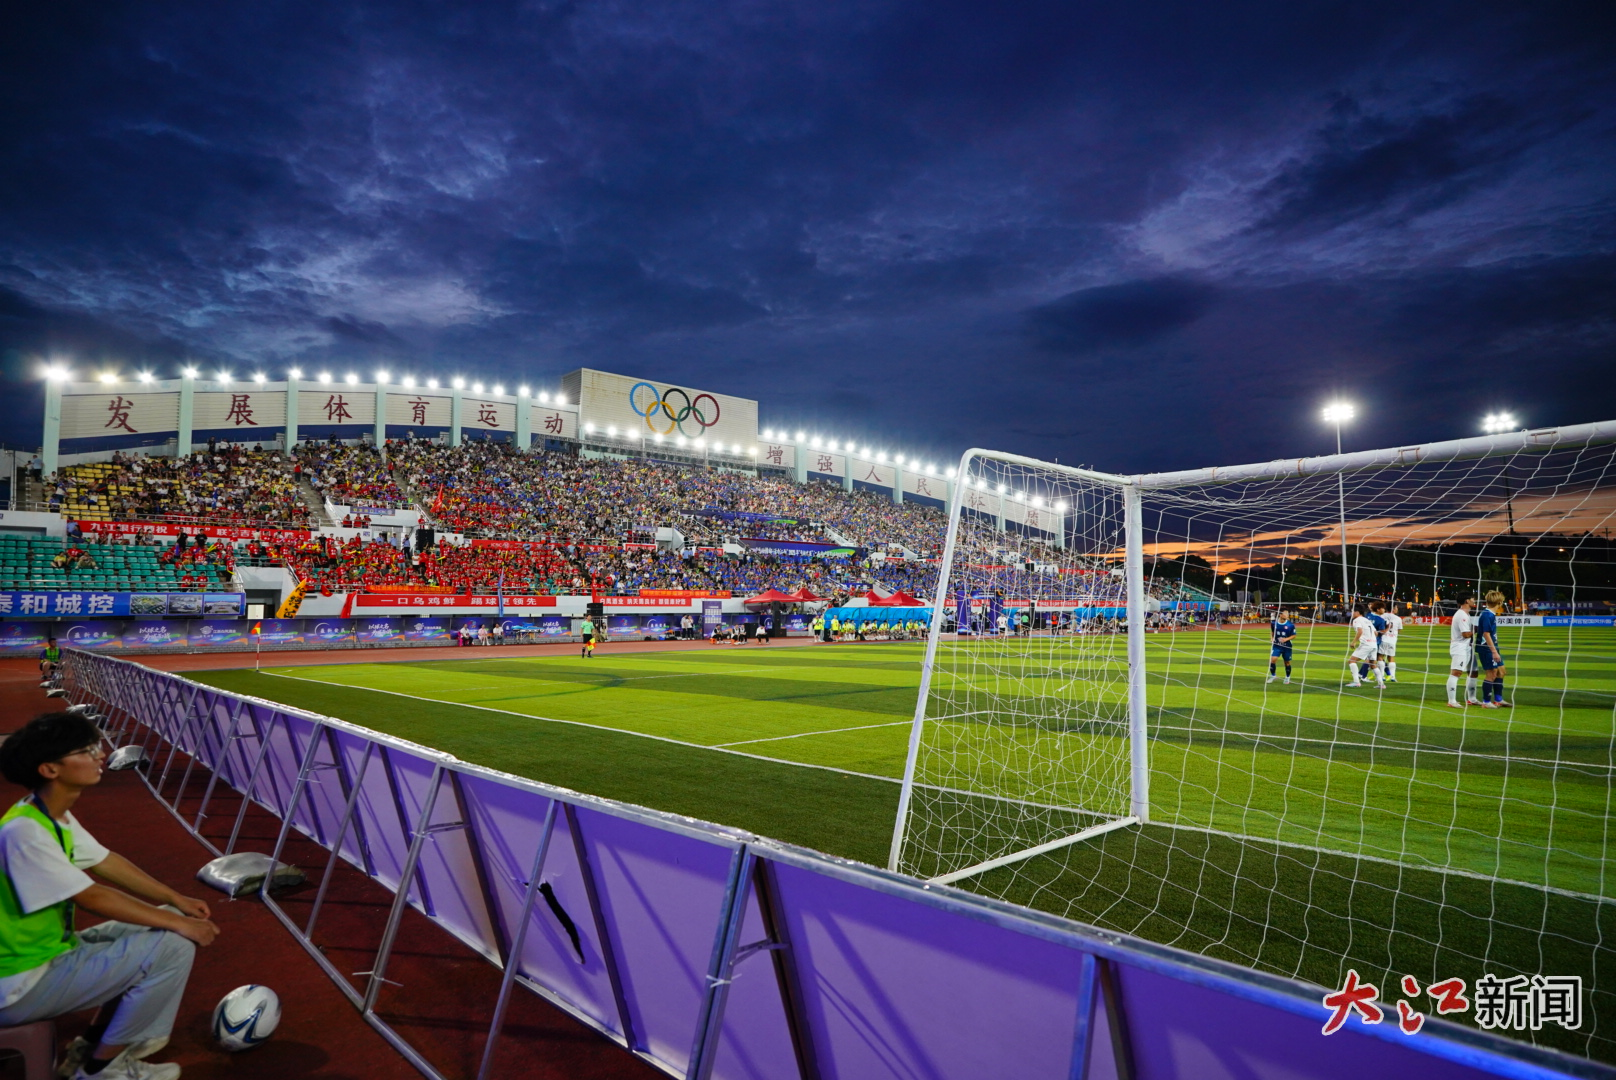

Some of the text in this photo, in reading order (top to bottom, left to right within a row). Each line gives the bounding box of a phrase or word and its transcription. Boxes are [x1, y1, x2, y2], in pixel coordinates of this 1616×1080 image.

[381, 597, 537, 606] 一口乌鸡鲜 踢球更领先
[1415, 616, 1440, 624] 煌上煌
